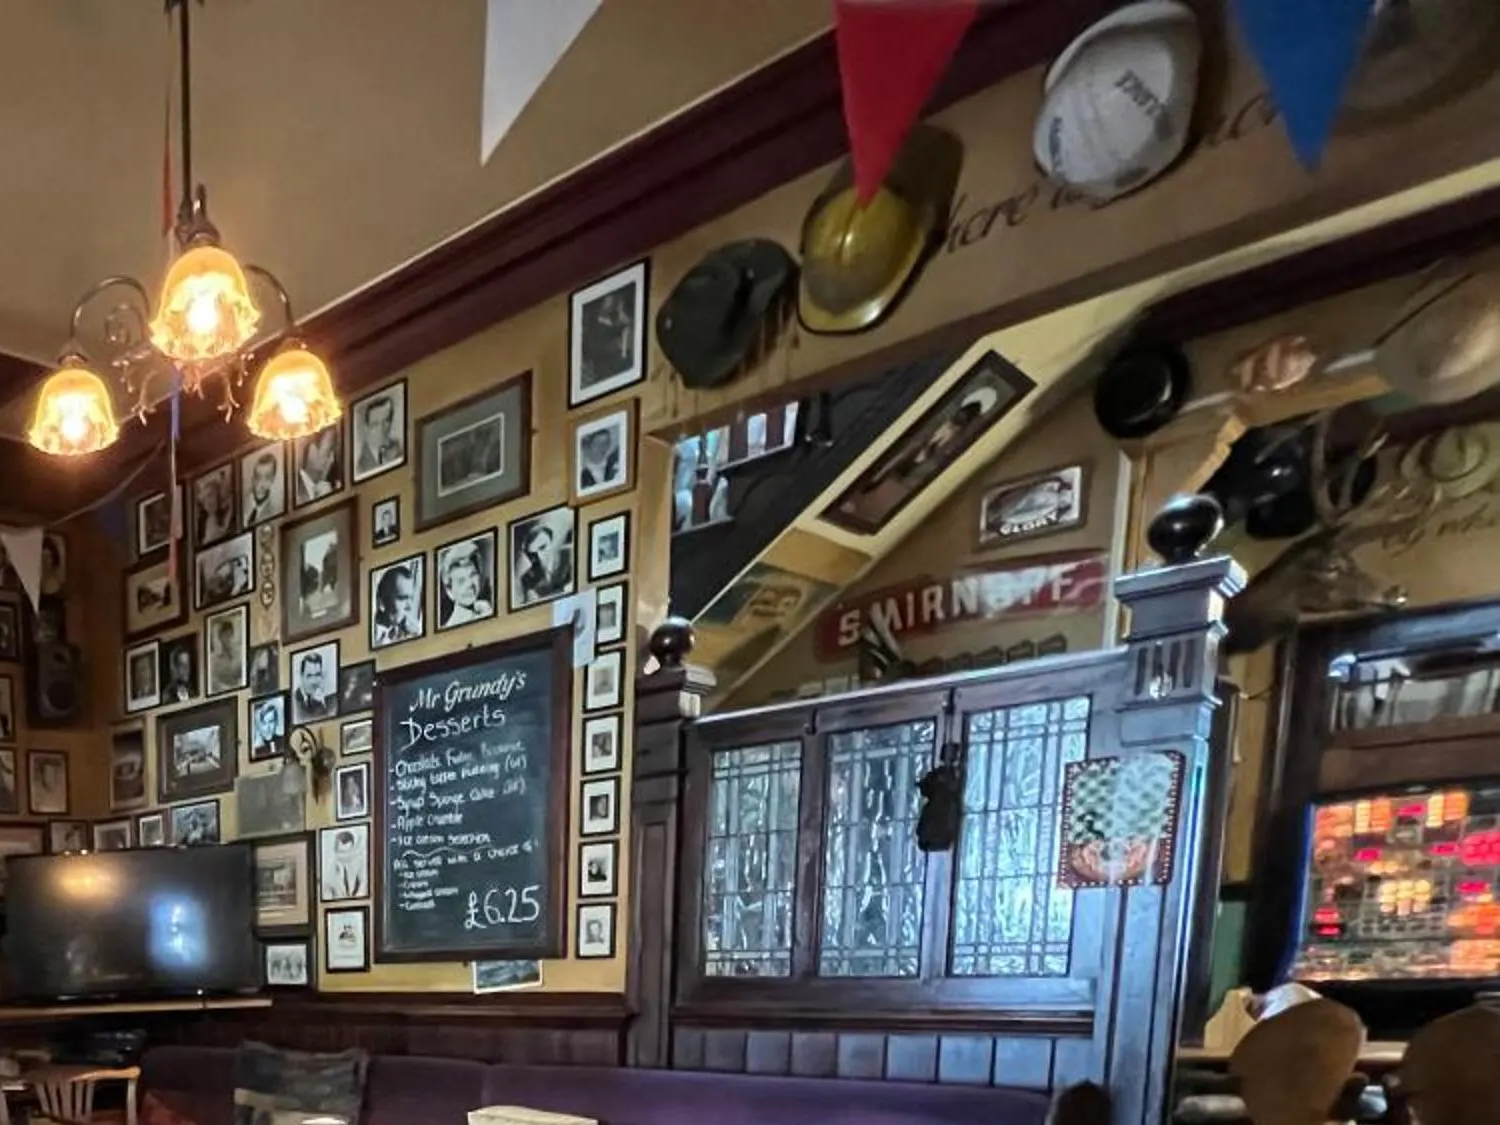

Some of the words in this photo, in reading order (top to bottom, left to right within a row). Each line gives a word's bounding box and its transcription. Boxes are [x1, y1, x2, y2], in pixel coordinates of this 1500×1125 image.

[409, 687, 441, 712] Mr
[444, 669, 528, 712] Grundy's
[400, 703, 506, 752] Desserts
[464, 884, 541, 930] £6.25
